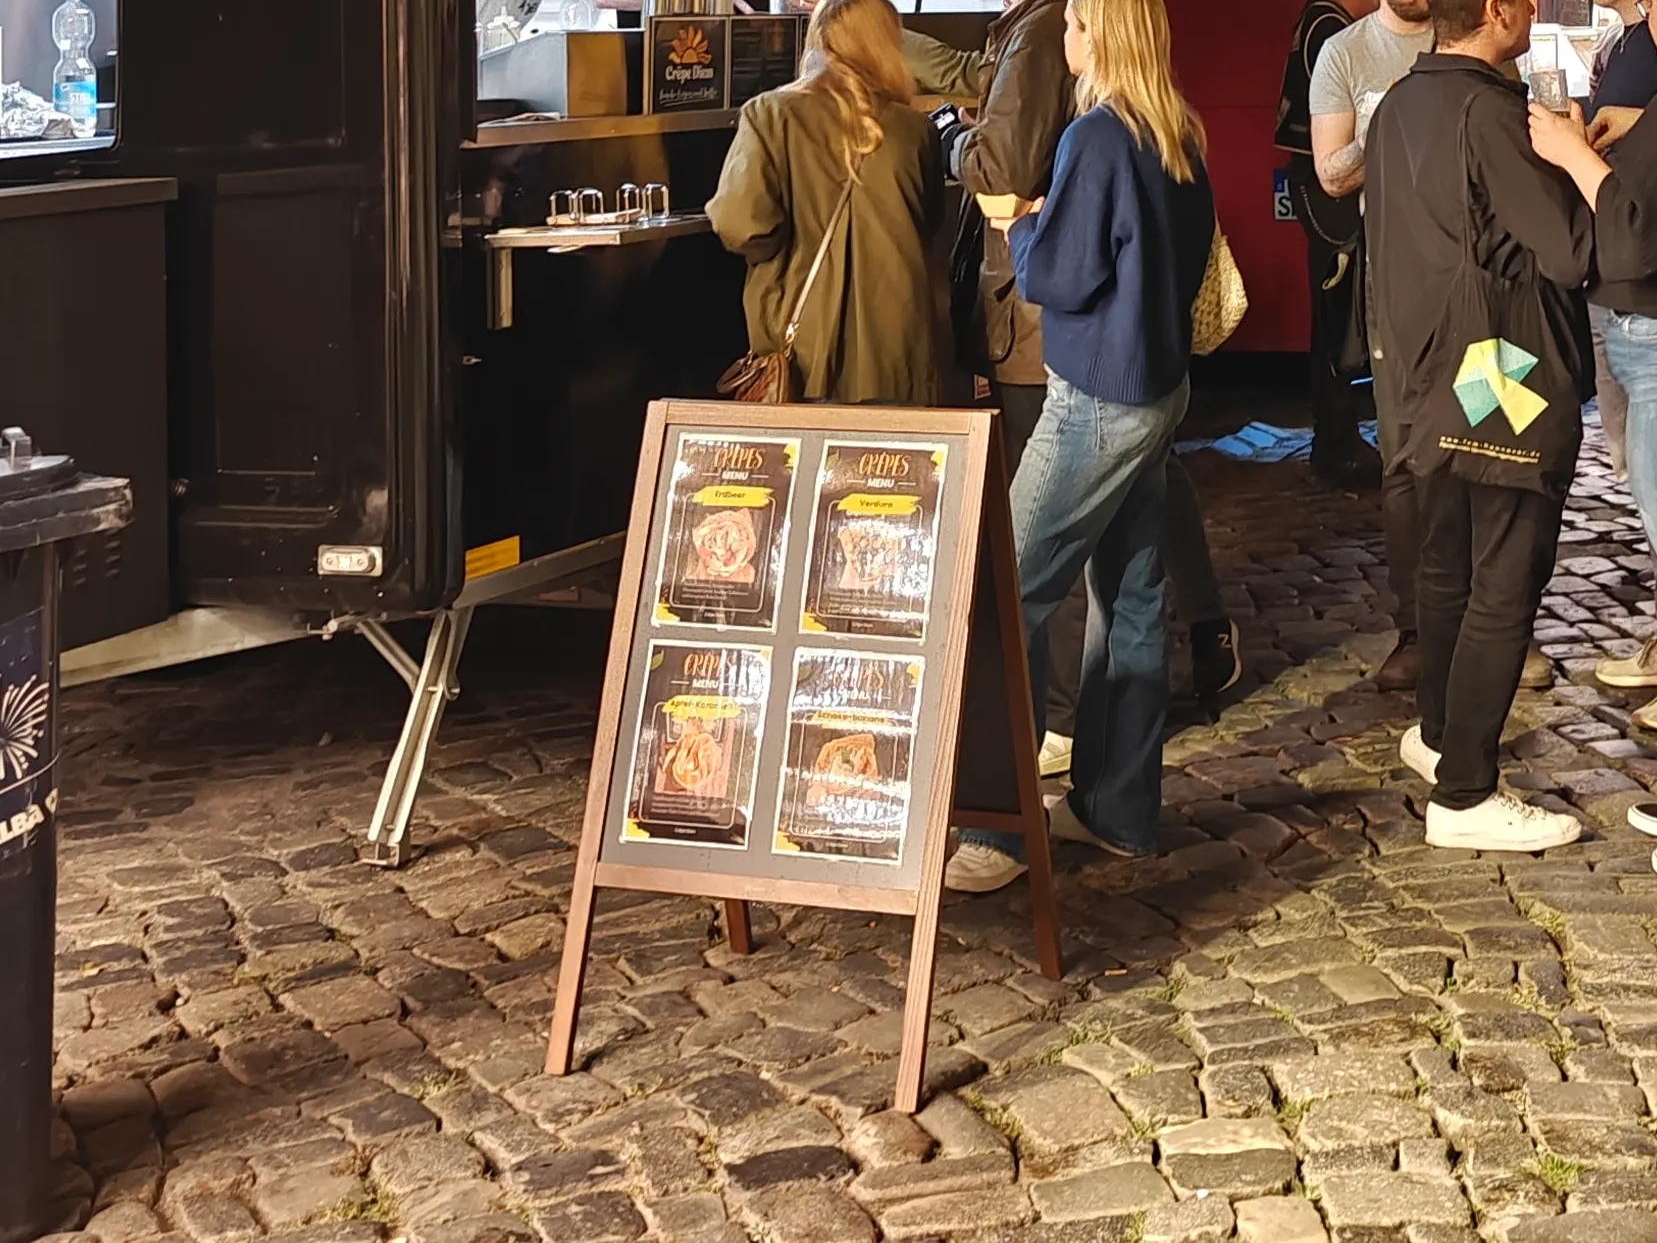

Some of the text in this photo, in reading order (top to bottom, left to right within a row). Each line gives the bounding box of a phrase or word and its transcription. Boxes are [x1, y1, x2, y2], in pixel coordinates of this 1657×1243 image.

[859, 451, 911, 476] CRÊPES
[721, 470, 750, 481] MENU
[867, 477, 895, 488] MENU
